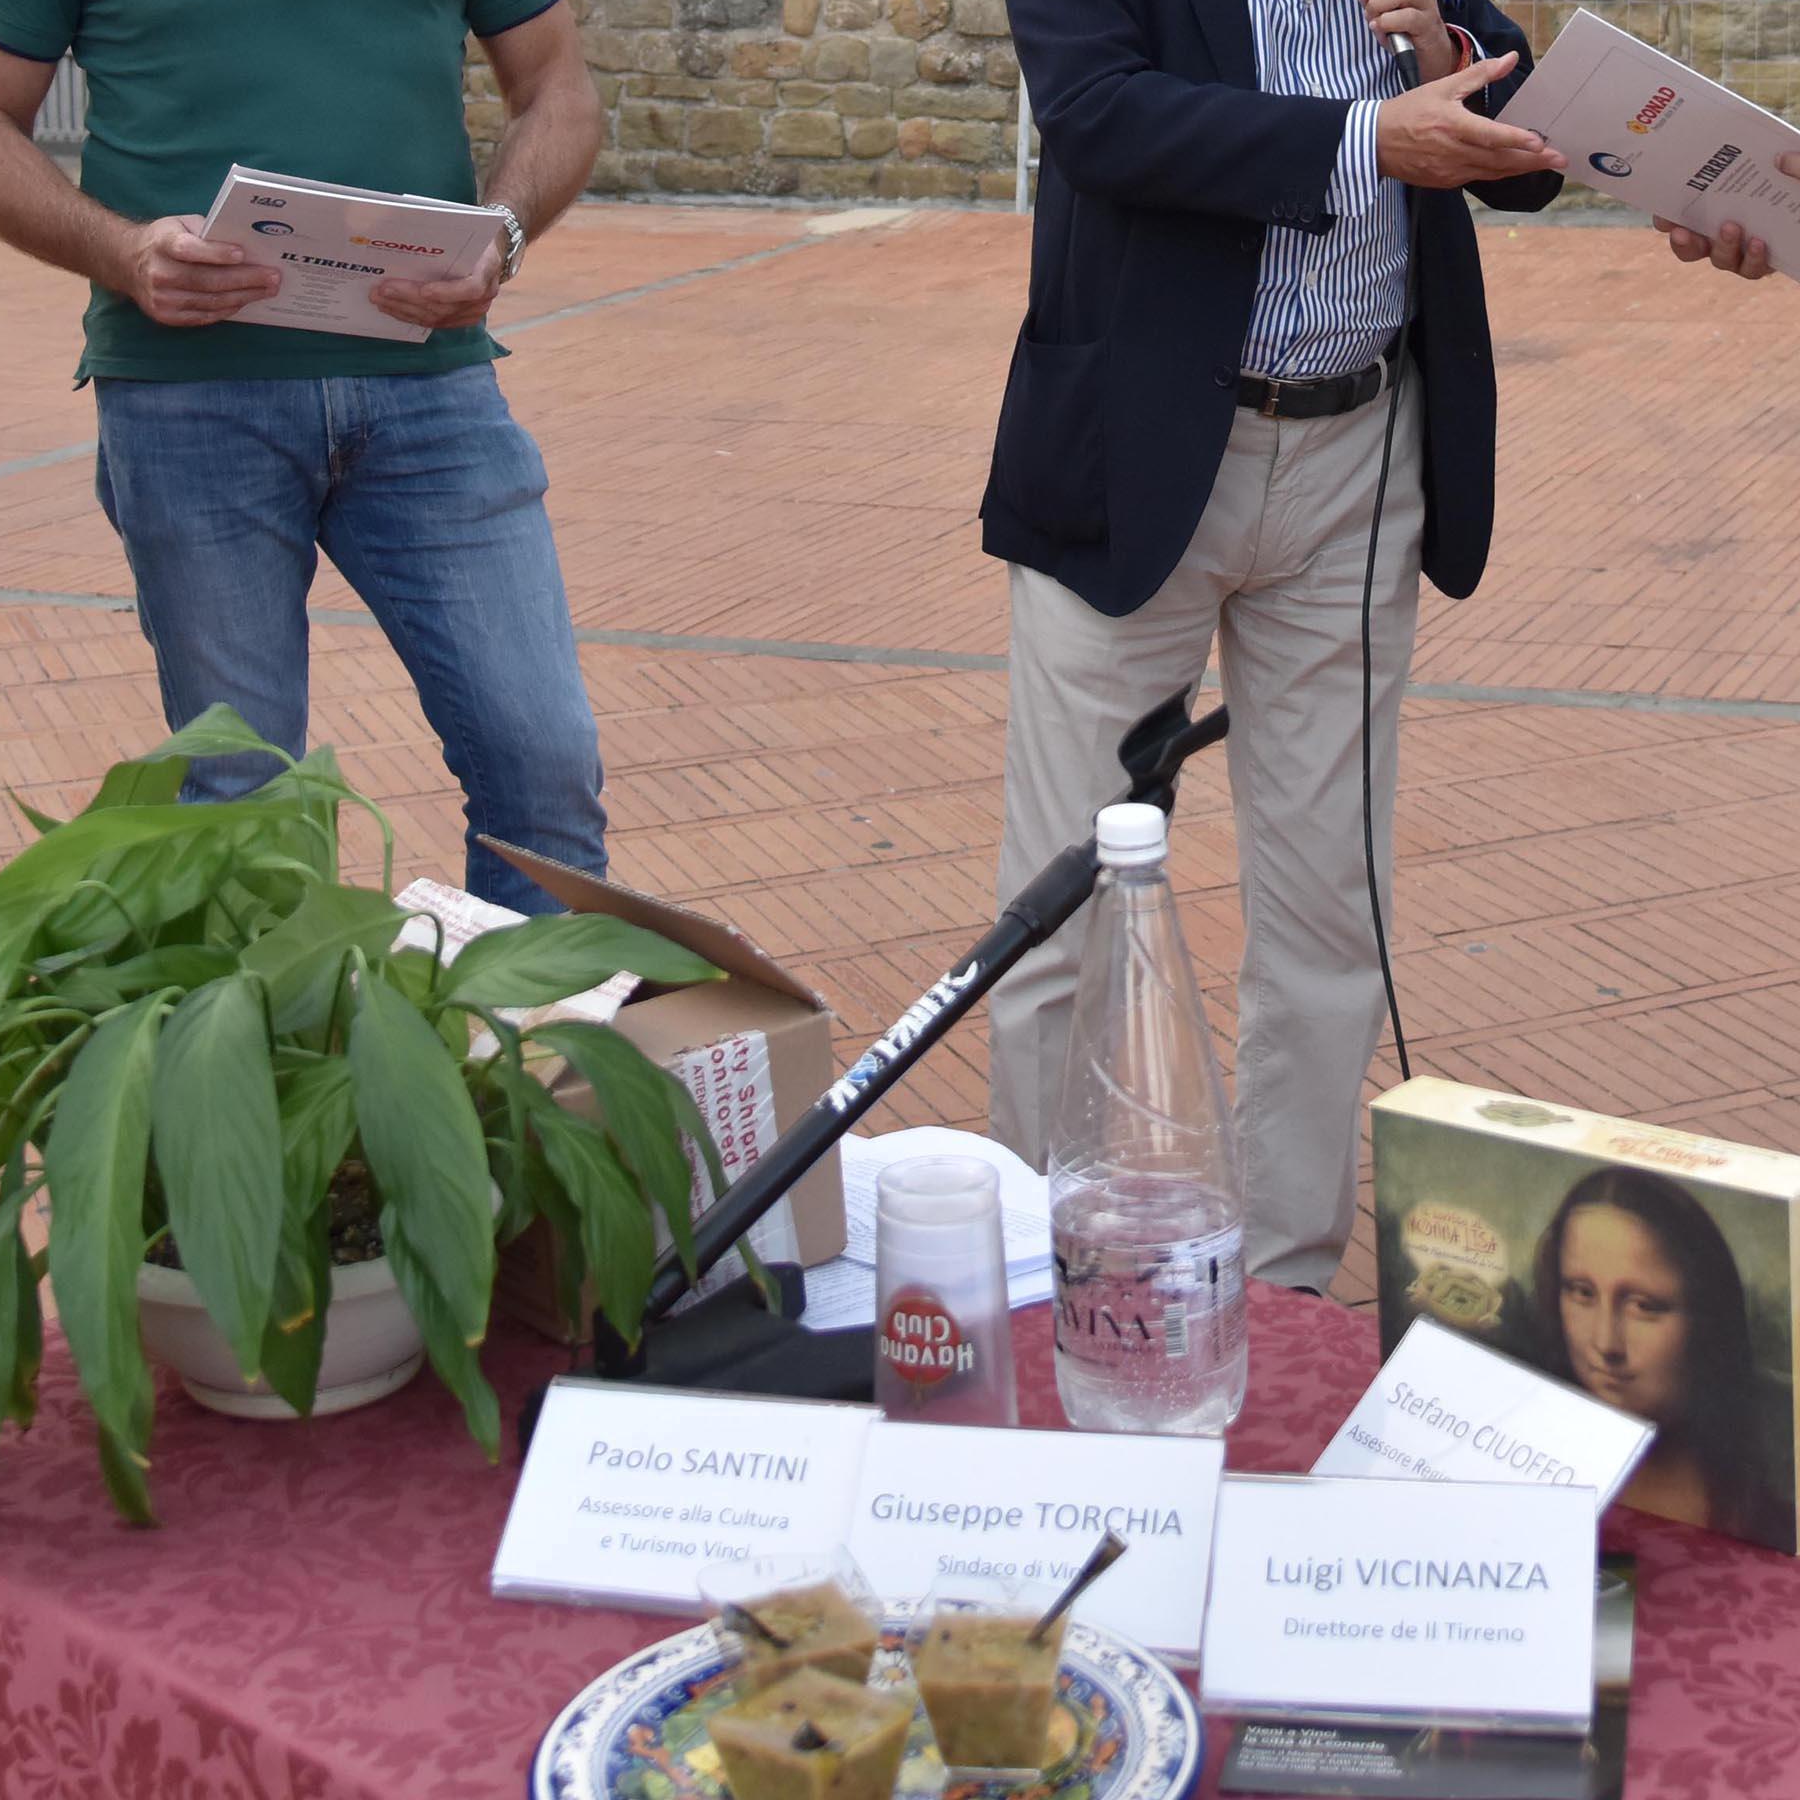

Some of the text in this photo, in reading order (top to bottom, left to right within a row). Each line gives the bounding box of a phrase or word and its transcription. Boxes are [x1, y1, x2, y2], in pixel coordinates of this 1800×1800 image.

[1636, 86, 1676, 125] CONAD
[1686, 143, 1743, 192] IL TIRRENO
[280, 252, 386, 276] IL TIRRENO
[371, 239, 445, 255] CONAD
[893, 1312, 950, 1343] Club
[880, 1334, 974, 1372] Havana
[1347, 1422, 1411, 1468] Assessore
[1387, 1381, 1575, 1487] Stefano CIUOFFO
[587, 1440, 809, 1482] Paolo SANTINI
[578, 1496, 790, 1530] Assessore alla Cultura
[870, 1493, 1184, 1536] Giuseppe TORCHIA
[600, 1532, 751, 1561] e Turismo Vinci
[937, 1553, 1017, 1578] Sindaco
[1023, 1559, 1042, 1578] di
[1265, 1556, 1550, 1592] Luigi VICINANZA
[1283, 1617, 1526, 1642] Direttore de Il Tirreno
[1243, 1735, 1386, 1751] la città di Leonardo
[1247, 1725, 1338, 1738] Vieni a Vinci
